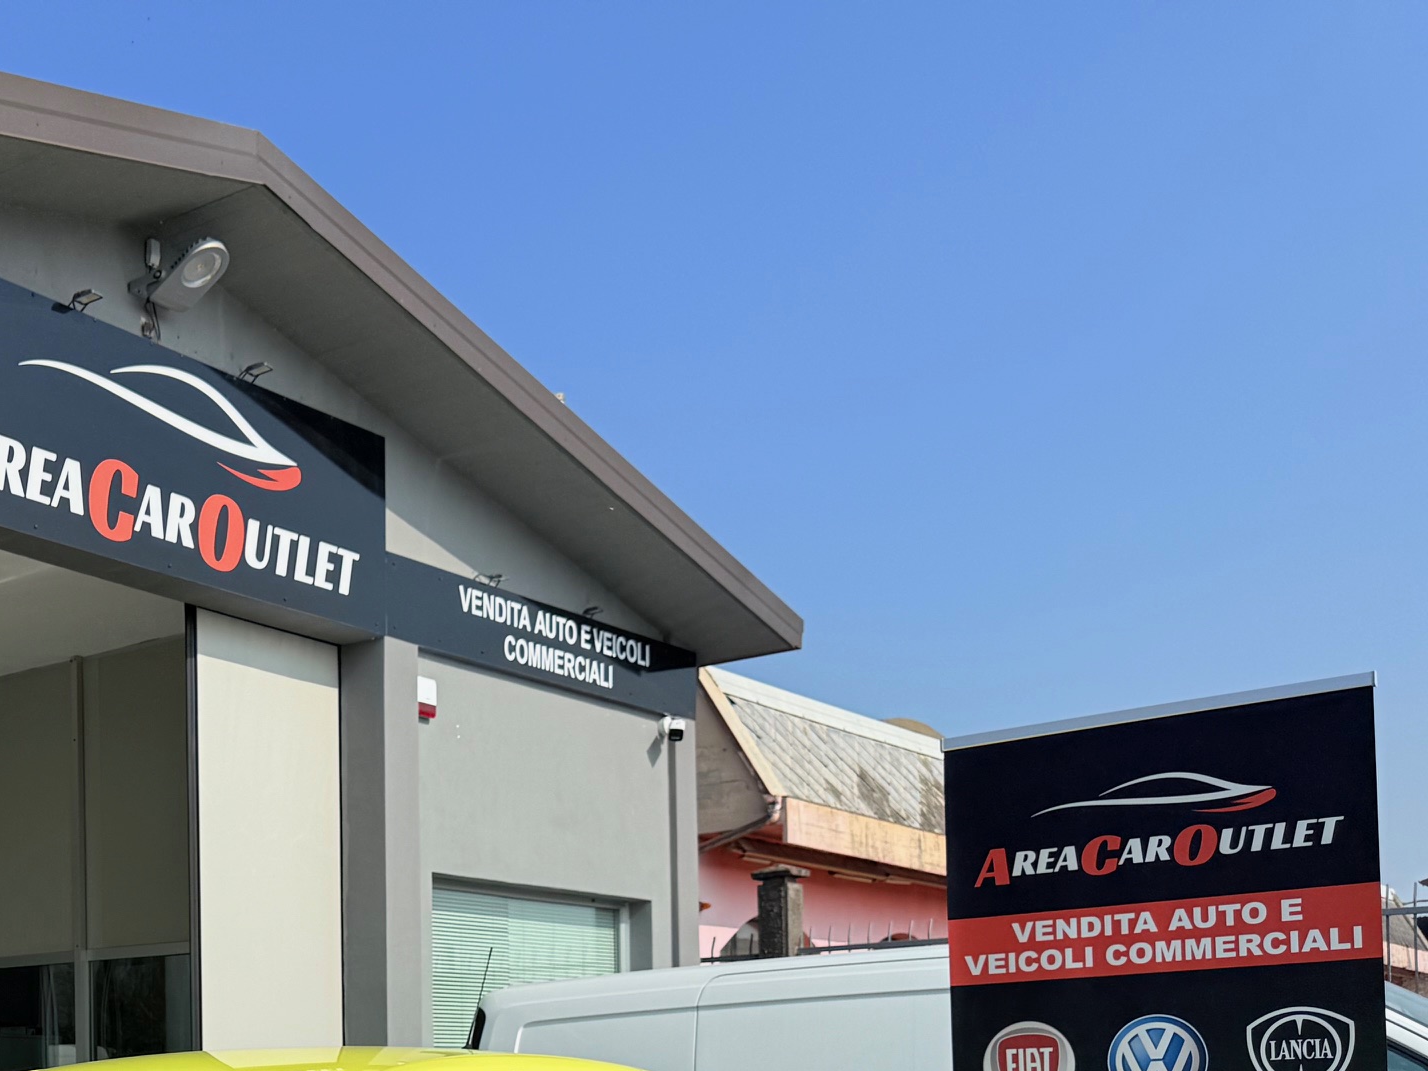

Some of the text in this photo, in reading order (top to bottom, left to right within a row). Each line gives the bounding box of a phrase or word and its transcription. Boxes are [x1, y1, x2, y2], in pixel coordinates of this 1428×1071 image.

[458, 585, 650, 668] VENDITA AUTO E VEICOLI
[503, 635, 614, 689] COMMERCIALI
[1011, 898, 1304, 944] VENDITA AUTO E
[965, 925, 1364, 976] VEICOLI COMMERCIALI
[1269, 1038, 1335, 1062] LANCIA
